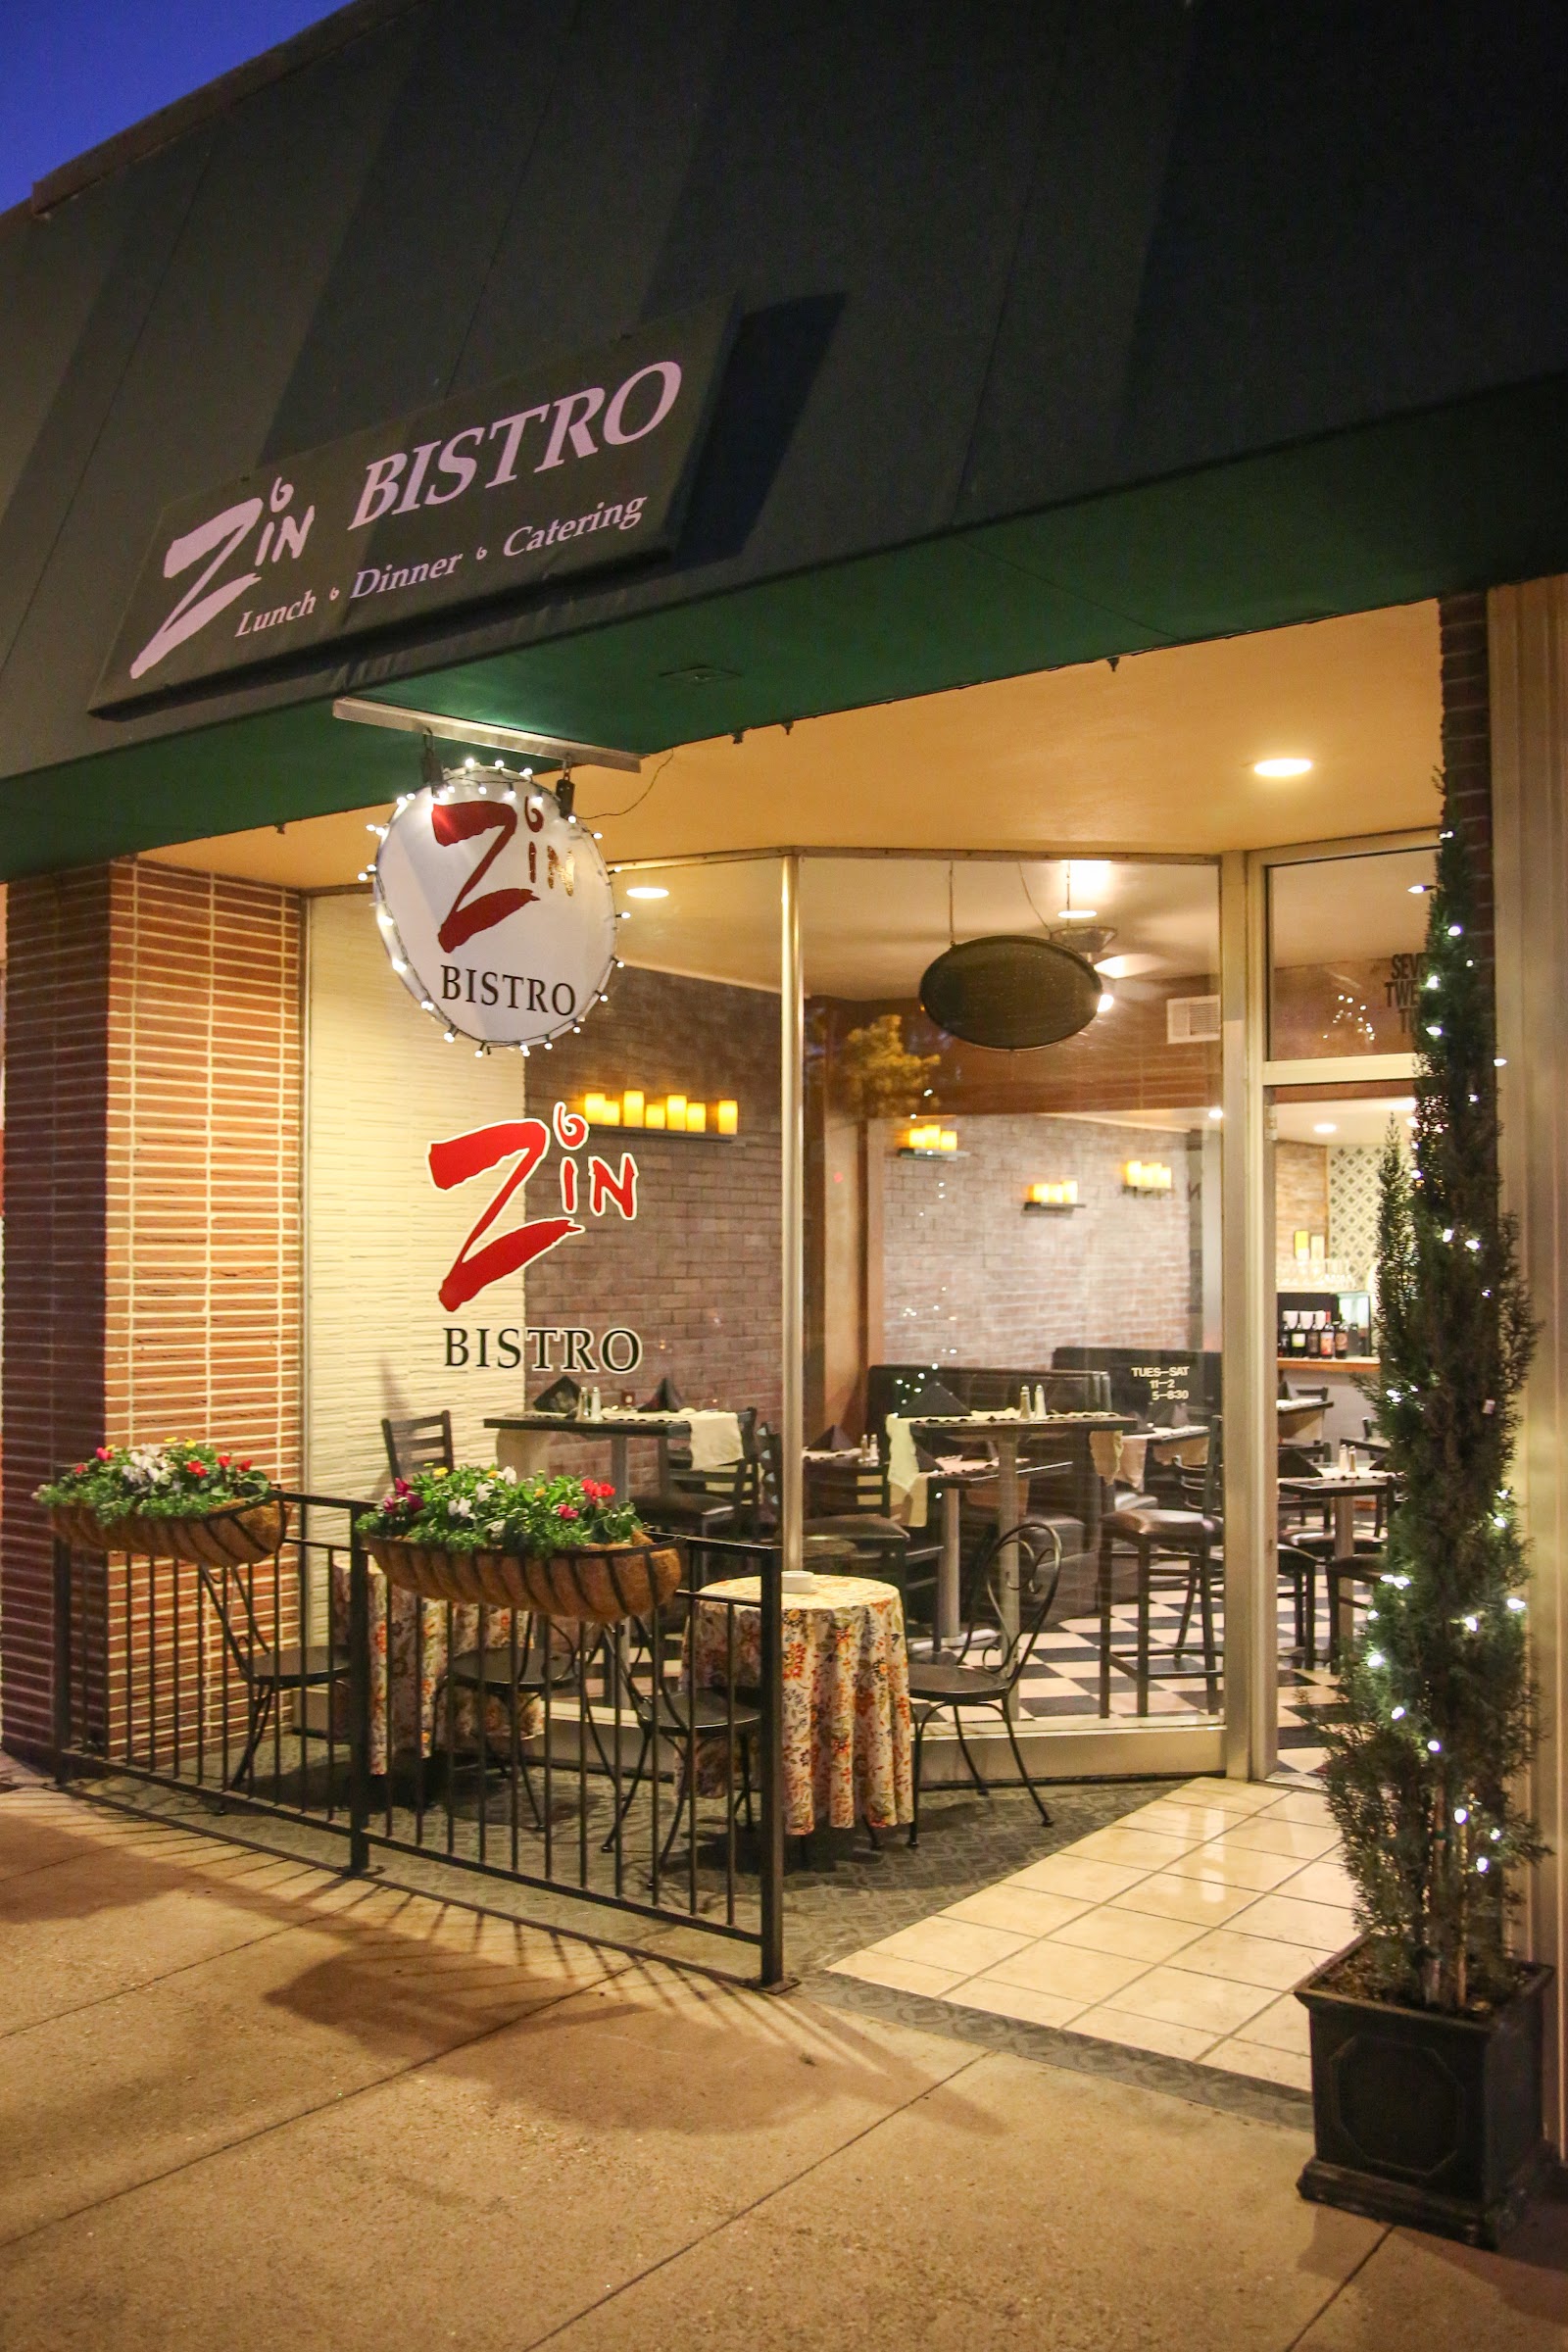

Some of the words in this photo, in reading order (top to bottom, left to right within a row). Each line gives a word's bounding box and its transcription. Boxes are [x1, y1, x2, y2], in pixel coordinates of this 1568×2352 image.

[347, 360, 682, 531] BISTRO
[234, 589, 317, 638] Lunch
[349, 553, 465, 600] Dinner
[503, 496, 648, 557] Catering
[440, 964, 576, 1016] BISTRO
[443, 1326, 642, 1373] BISTRO
